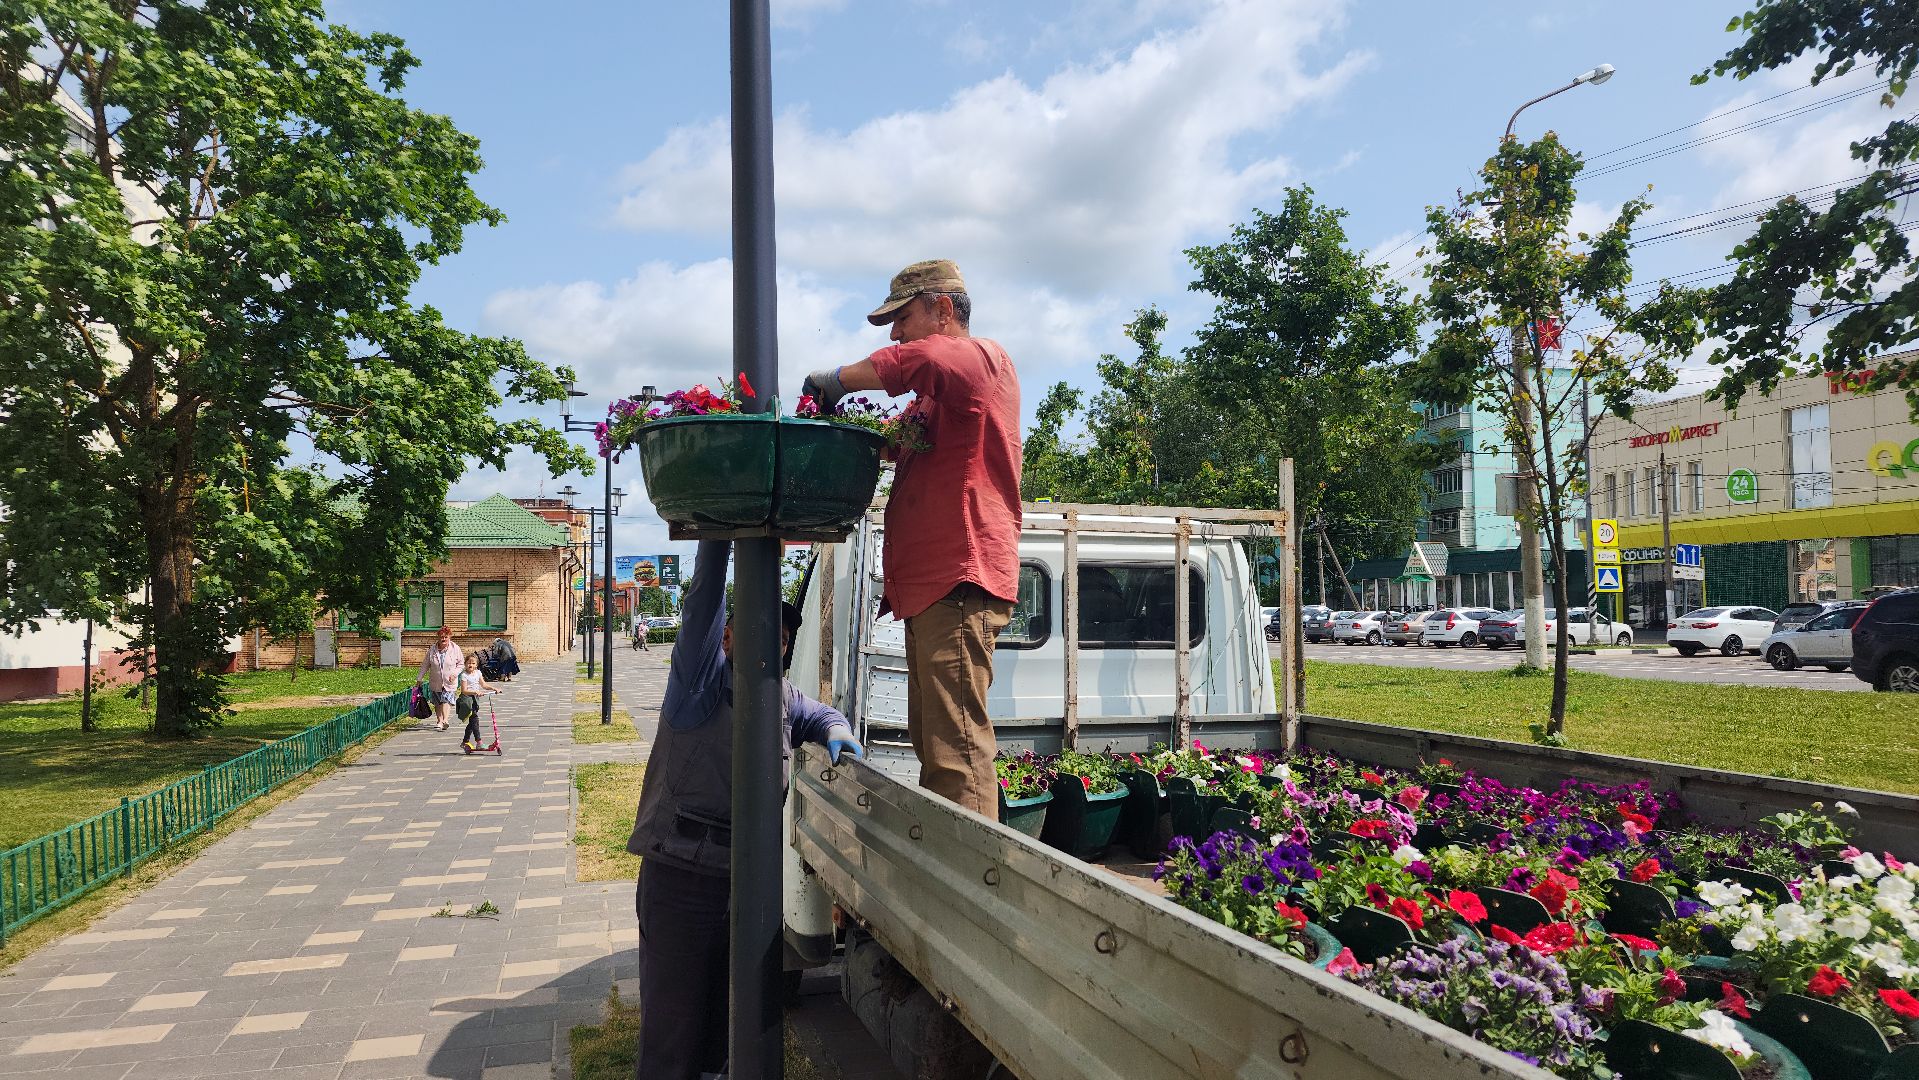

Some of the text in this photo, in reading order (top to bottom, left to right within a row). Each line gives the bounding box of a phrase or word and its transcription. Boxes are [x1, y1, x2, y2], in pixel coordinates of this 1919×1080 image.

[1628, 422, 1719, 448] ЭКОНОМАРКЕТ
[1732, 476, 1748, 490] 24
[1600, 528, 1611, 537] 20
